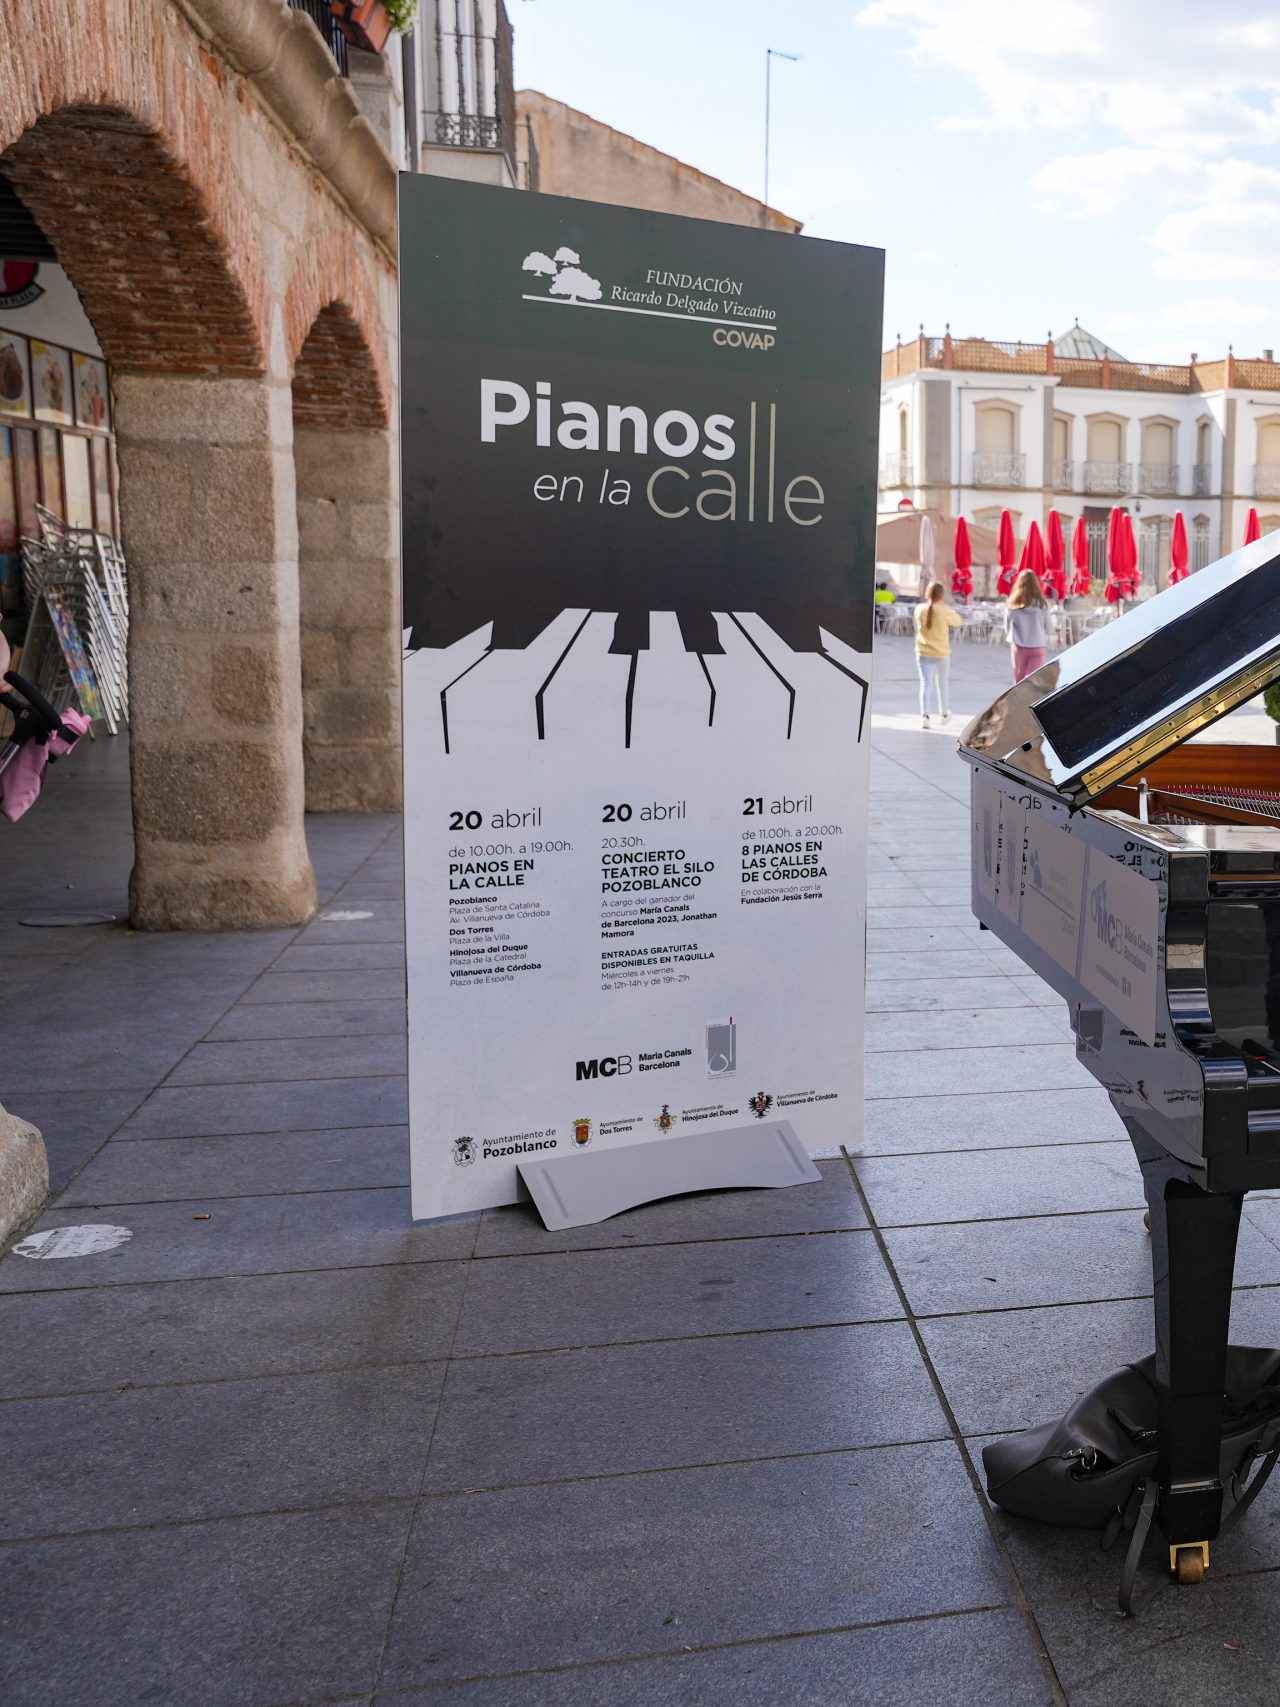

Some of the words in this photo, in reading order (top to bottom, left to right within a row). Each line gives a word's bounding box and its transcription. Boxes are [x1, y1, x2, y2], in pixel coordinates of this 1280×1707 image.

[646, 268, 743, 297] FUNDACIÓN
[611, 285, 662, 306] Ricardo
[666, 292, 718, 314] Delgado
[723, 299, 776, 321] Vizcaíno
[713, 328, 775, 351] COVAP
[480, 378, 736, 460] Pianos
[534, 474, 584, 502] en
[600, 469, 631, 505] la
[646, 401, 825, 526] calle
[602, 804, 632, 822] 20
[640, 800, 685, 821] abril
[743, 798, 763, 815] 21
[771, 795, 812, 814] abril
[449, 811, 482, 830] 20
[491, 807, 541, 828] abril
[742, 830, 755, 840] de
[759, 828, 792, 839] 11.00h.
[796, 829, 801, 837] a
[805, 825, 843, 836] 20.00h.
[449, 847, 465, 857] de
[470, 844, 515, 856] 10.00h.
[519, 845, 526, 853] a
[531, 841, 573, 852] 19.00h.
[602, 837, 645, 848] 20.30h.
[742, 846, 749, 855] 8
[754, 843, 802, 855] PIANOS
[806, 841, 822, 851] EN
[602, 850, 685, 865] CONCIERTO
[742, 858, 766, 869] LAS
[771, 854, 818, 867] CALLES
[450, 861, 508, 875] PIANOS
[514, 859, 534, 870] EN
[602, 865, 659, 879] TEATRO
[664, 864, 679, 874] EL
[684, 861, 714, 873] SILO
[742, 872, 759, 882] DE
[763, 867, 827, 881] CÓRDOBA
[450, 878, 470, 890] LA
[475, 875, 524, 888] CALLE
[602, 876, 701, 893] POZOBLANCO
[753, 886, 798, 895] colaboración
[450, 896, 497, 905] Pozoblanco
[509, 902, 540, 910] Catalina
[610, 899, 632, 907] cargo
[649, 894, 681, 904] ganador
[741, 896, 779, 904] Fundación
[464, 914, 502, 923] Villanueva
[517, 910, 550, 918] Córdoba
[601, 909, 638, 918] concurso
[664, 904, 689, 912] Canals
[615, 917, 654, 927] Barcelona
[681, 913, 717, 921] Jonathan
[601, 930, 634, 938] Mamora
[1098, 906, 1122, 954] MCB
[450, 948, 485, 956] Hinojosa
[502, 944, 528, 952] Duque
[494, 953, 526, 961] Catedral
[602, 948, 648, 959] ENTRADAS
[651, 944, 698, 954] GRATUITAS
[602, 958, 657, 969] DISPONIBLES
[674, 952, 714, 962] TAQUILLA
[450, 967, 492, 977] Villanueva
[507, 962, 541, 971] Córdoba
[602, 971, 638, 980] Miércoles
[647, 967, 674, 975] viernes
[486, 975, 514, 983] España
[651, 977, 660, 985] de
[576, 1055, 632, 1081] MCB
[639, 1052, 662, 1062] Maria
[665, 1048, 692, 1058] Canals
[639, 1060, 680, 1072] Barcelona
[777, 1091, 808, 1100] Ayuntamiento
[777, 1098, 806, 1107] Villanueva
[815, 1093, 837, 1102] Córdoba
[682, 1105, 716, 1114] Ayuntamiento
[682, 1113, 708, 1122] Hinojosa
[720, 1108, 738, 1117] Duque
[600, 1118, 636, 1128] Ayuntamiento
[613, 1125, 632, 1133] Torres
[482, 1131, 543, 1147] Ayuntamiento
[483, 1140, 557, 1159] Pozoblanco
